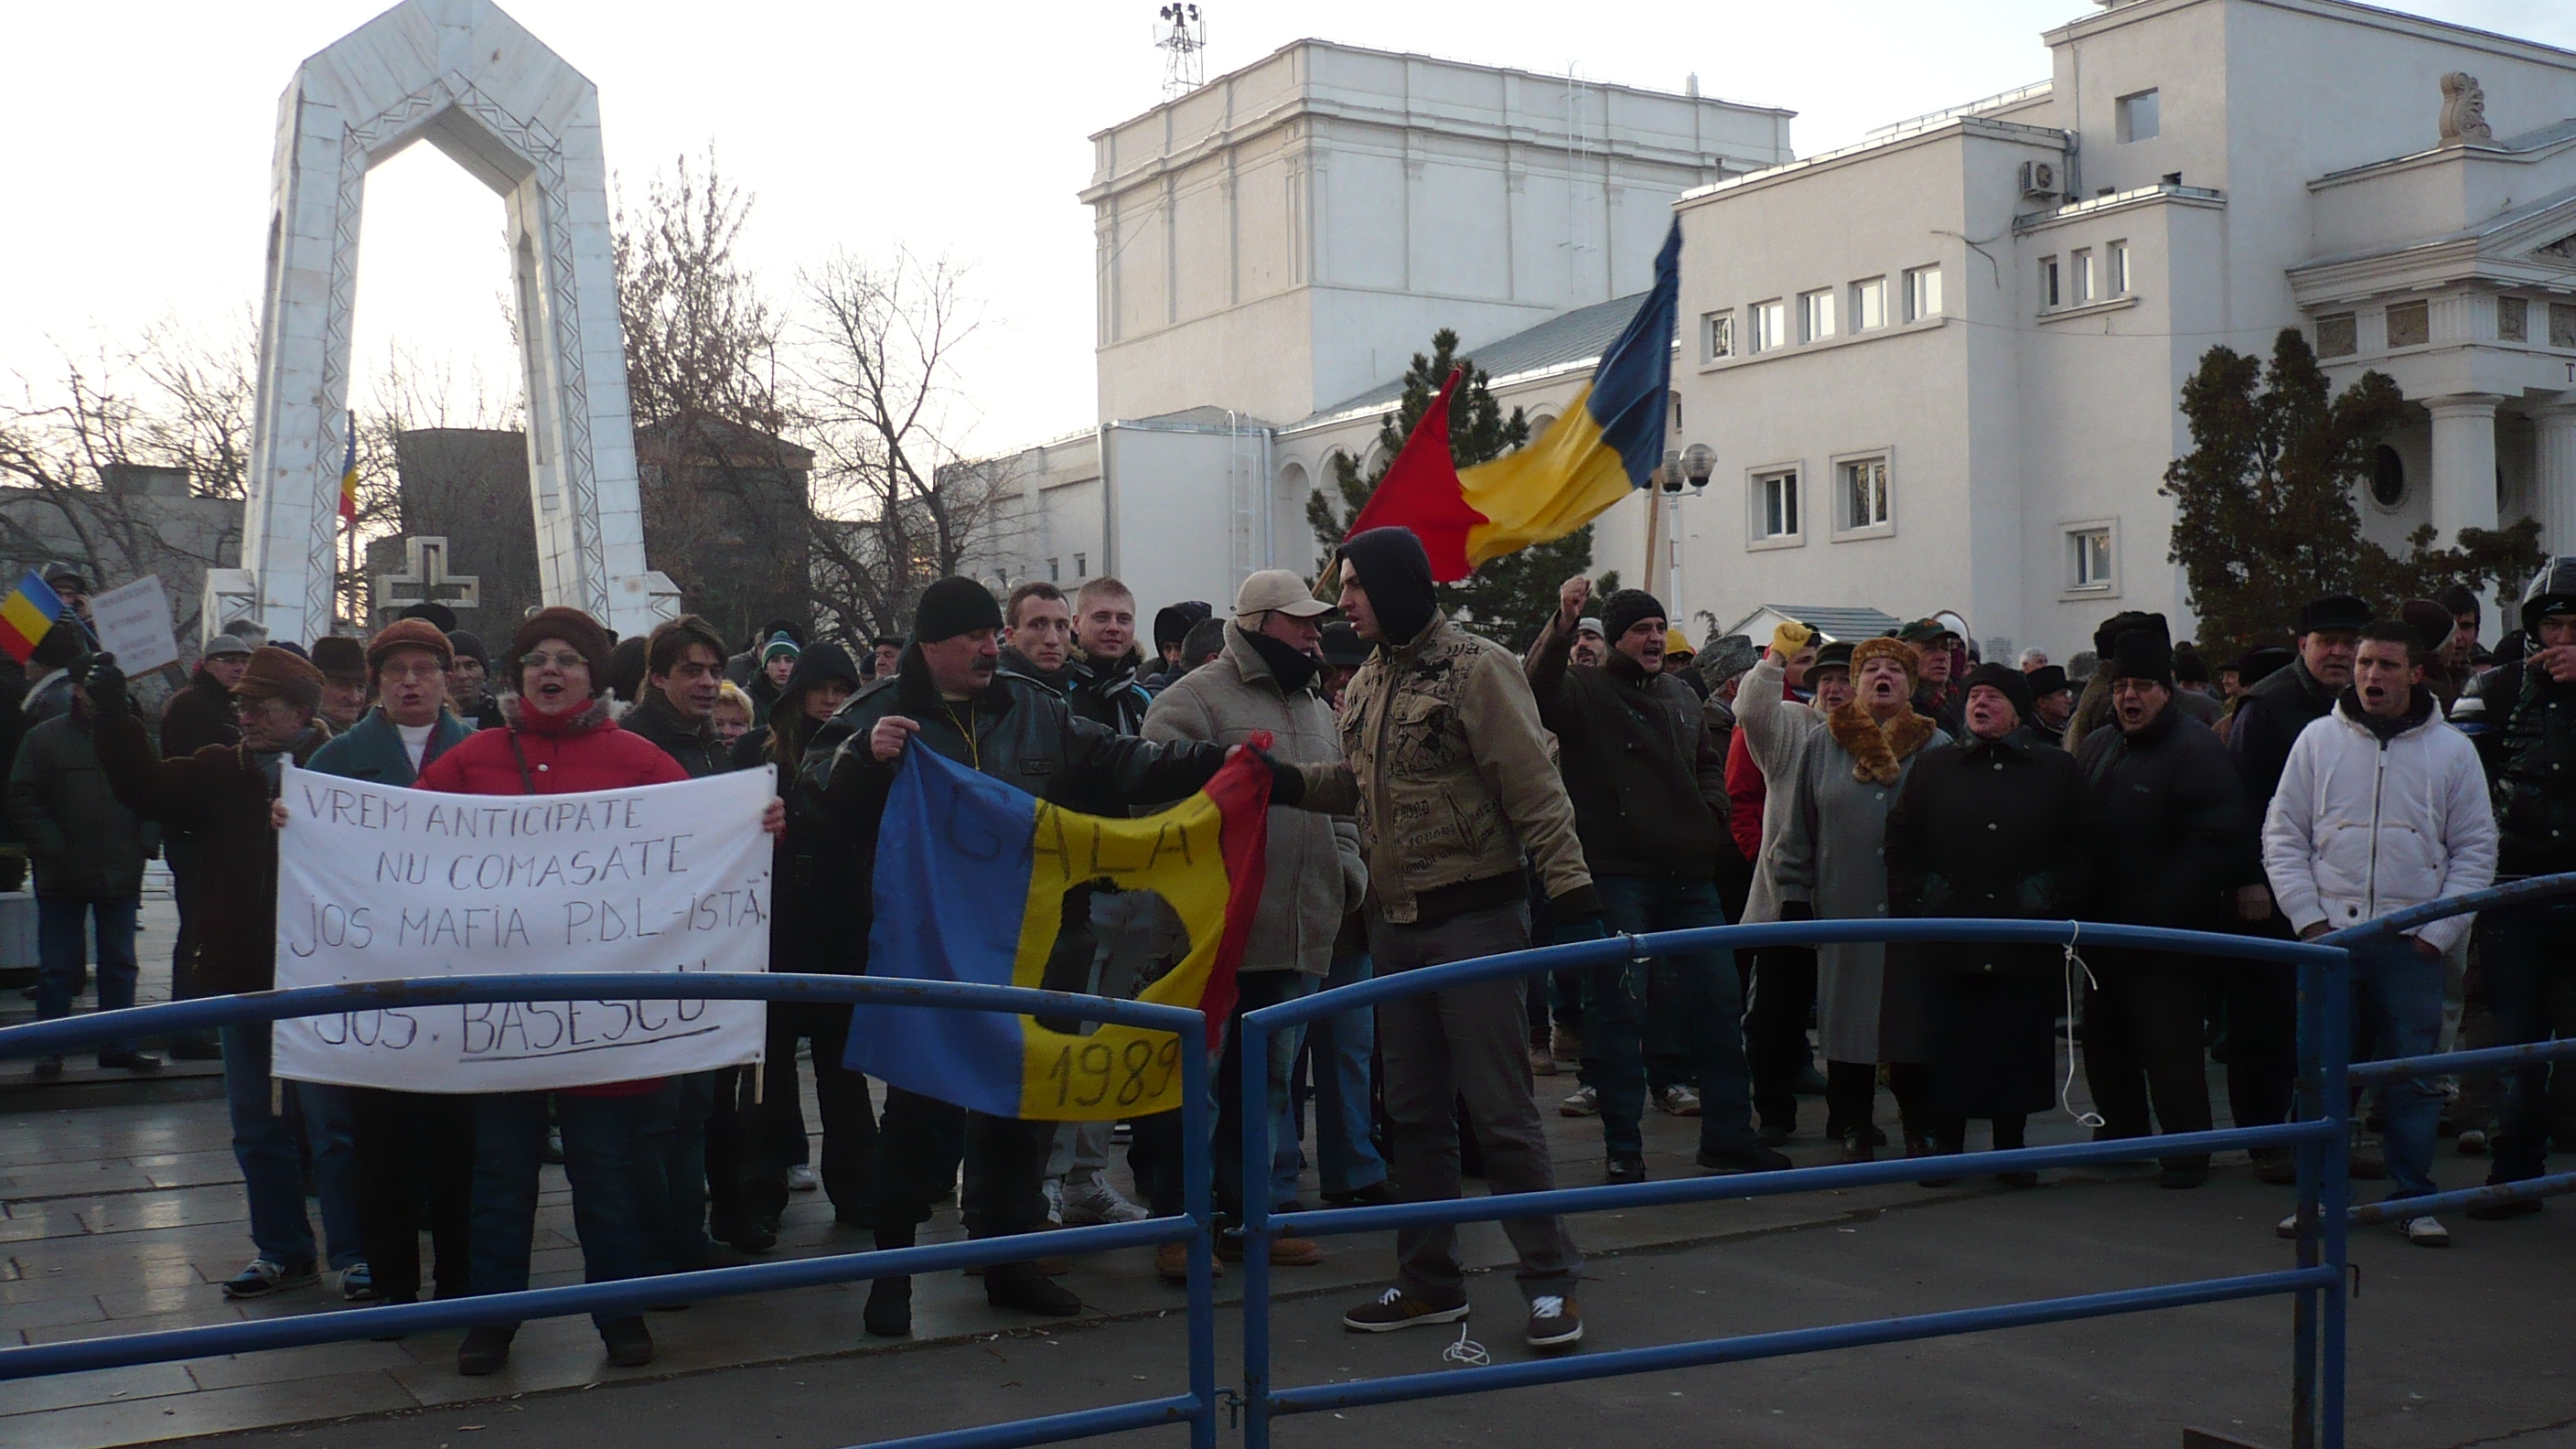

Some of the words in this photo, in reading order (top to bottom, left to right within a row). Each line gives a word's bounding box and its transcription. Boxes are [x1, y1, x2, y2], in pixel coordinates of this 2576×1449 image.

[303, 784, 409, 832] VREM
[425, 798, 644, 838] ANTICIPATE
[376, 852, 429, 886] NU
[447, 834, 693, 891] COMASATE
[290, 895, 373, 958] JOS
[1048, 1037, 1183, 1110] 1989
